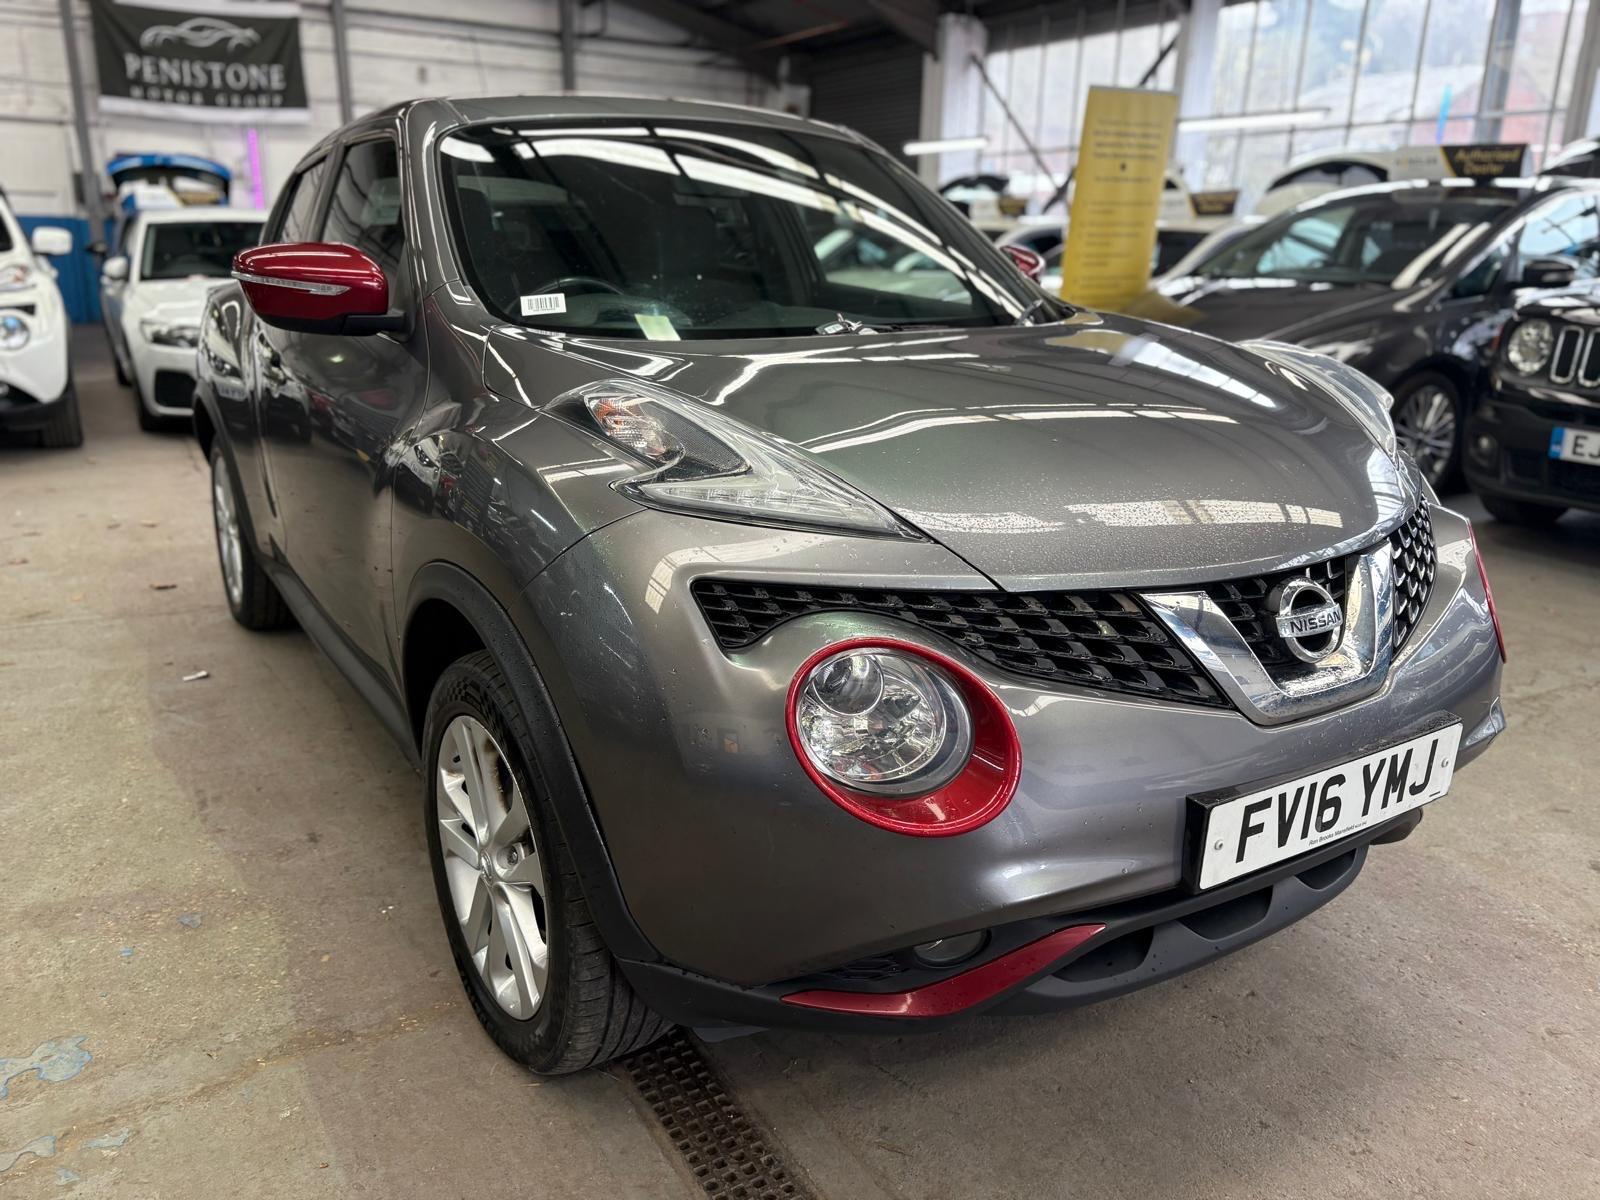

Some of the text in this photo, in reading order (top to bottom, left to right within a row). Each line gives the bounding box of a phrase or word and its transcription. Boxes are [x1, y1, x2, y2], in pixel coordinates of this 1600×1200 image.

[124, 53, 287, 91] PENISTONE
[129, 85, 204, 106] MOTOR
[1290, 611, 1341, 633] NISSAN
[1235, 739, 1439, 863] FV16 YMJ
